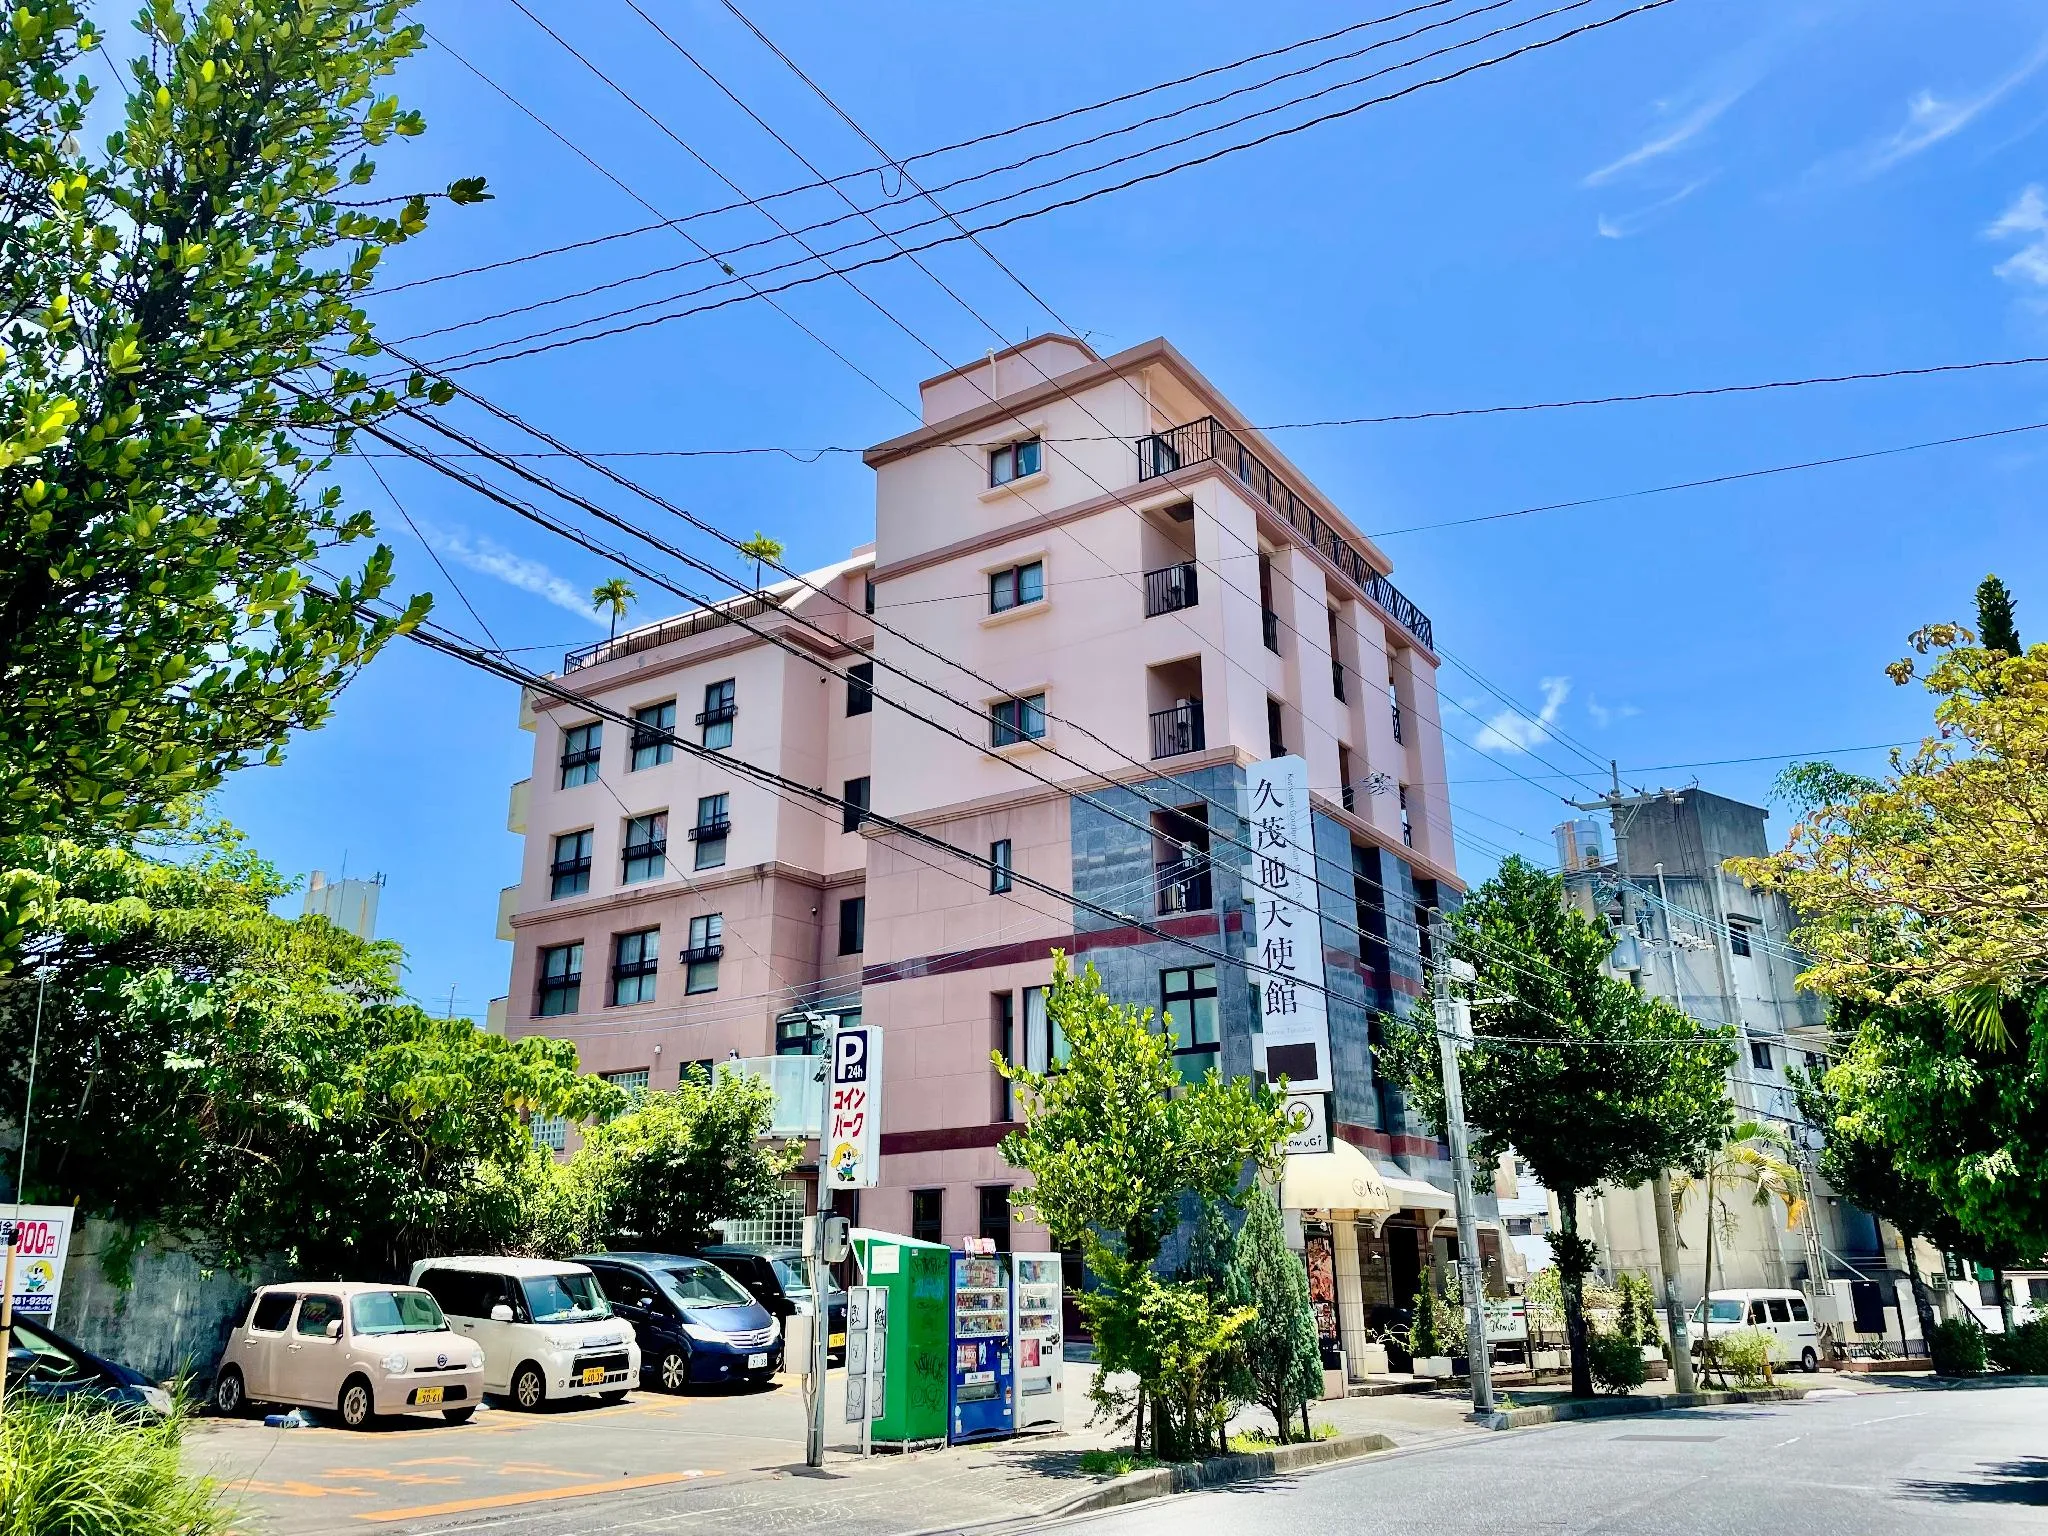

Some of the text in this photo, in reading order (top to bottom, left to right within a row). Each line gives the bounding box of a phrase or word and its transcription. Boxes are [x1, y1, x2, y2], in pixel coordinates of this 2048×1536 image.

[1253, 778, 1297, 1016] 久茂地天使館
[837, 1036, 863, 1079] P
[847, 1064, 864, 1079] 24h
[833, 1087, 866, 1110] コイン
[833, 1112, 864, 1138] パーク
